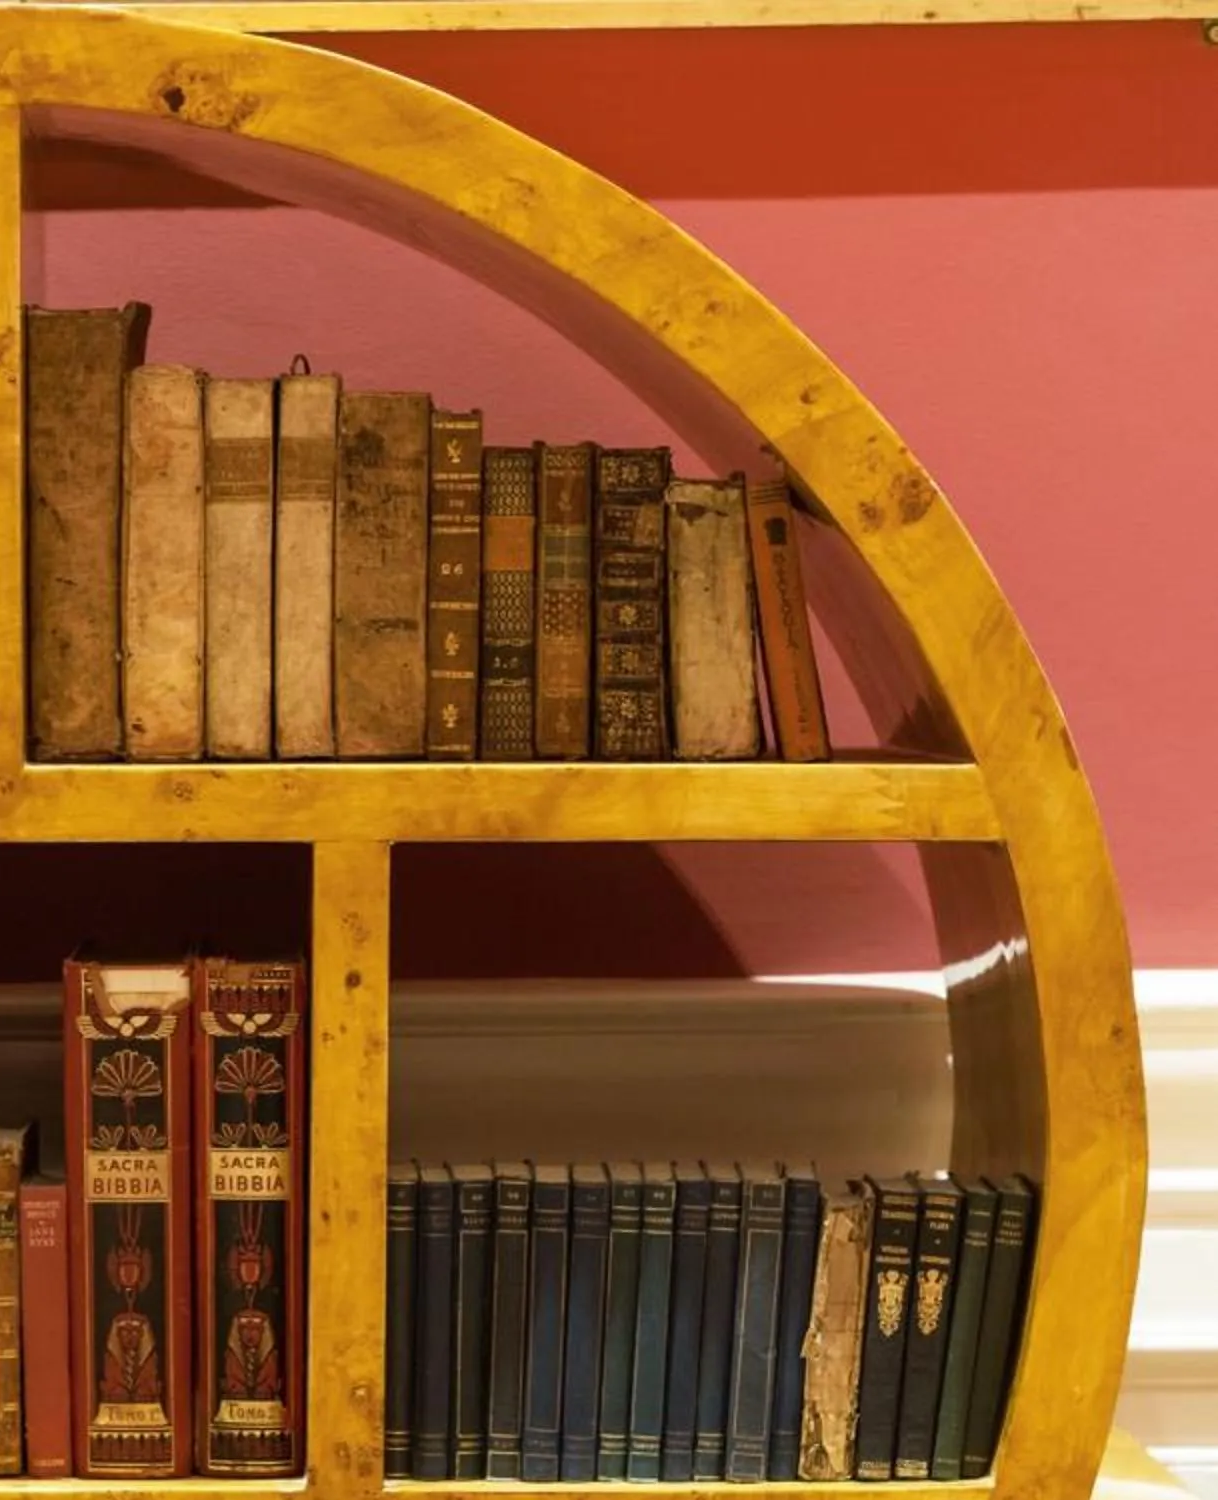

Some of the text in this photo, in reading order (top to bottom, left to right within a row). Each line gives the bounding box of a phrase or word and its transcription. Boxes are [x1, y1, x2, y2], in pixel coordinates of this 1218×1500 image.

[96, 1158, 158, 1172] SACRA
[219, 1155, 280, 1169] SACRA
[91, 1176, 165, 1196] BIBBIA
[213, 1174, 286, 1193] BIBBIA
